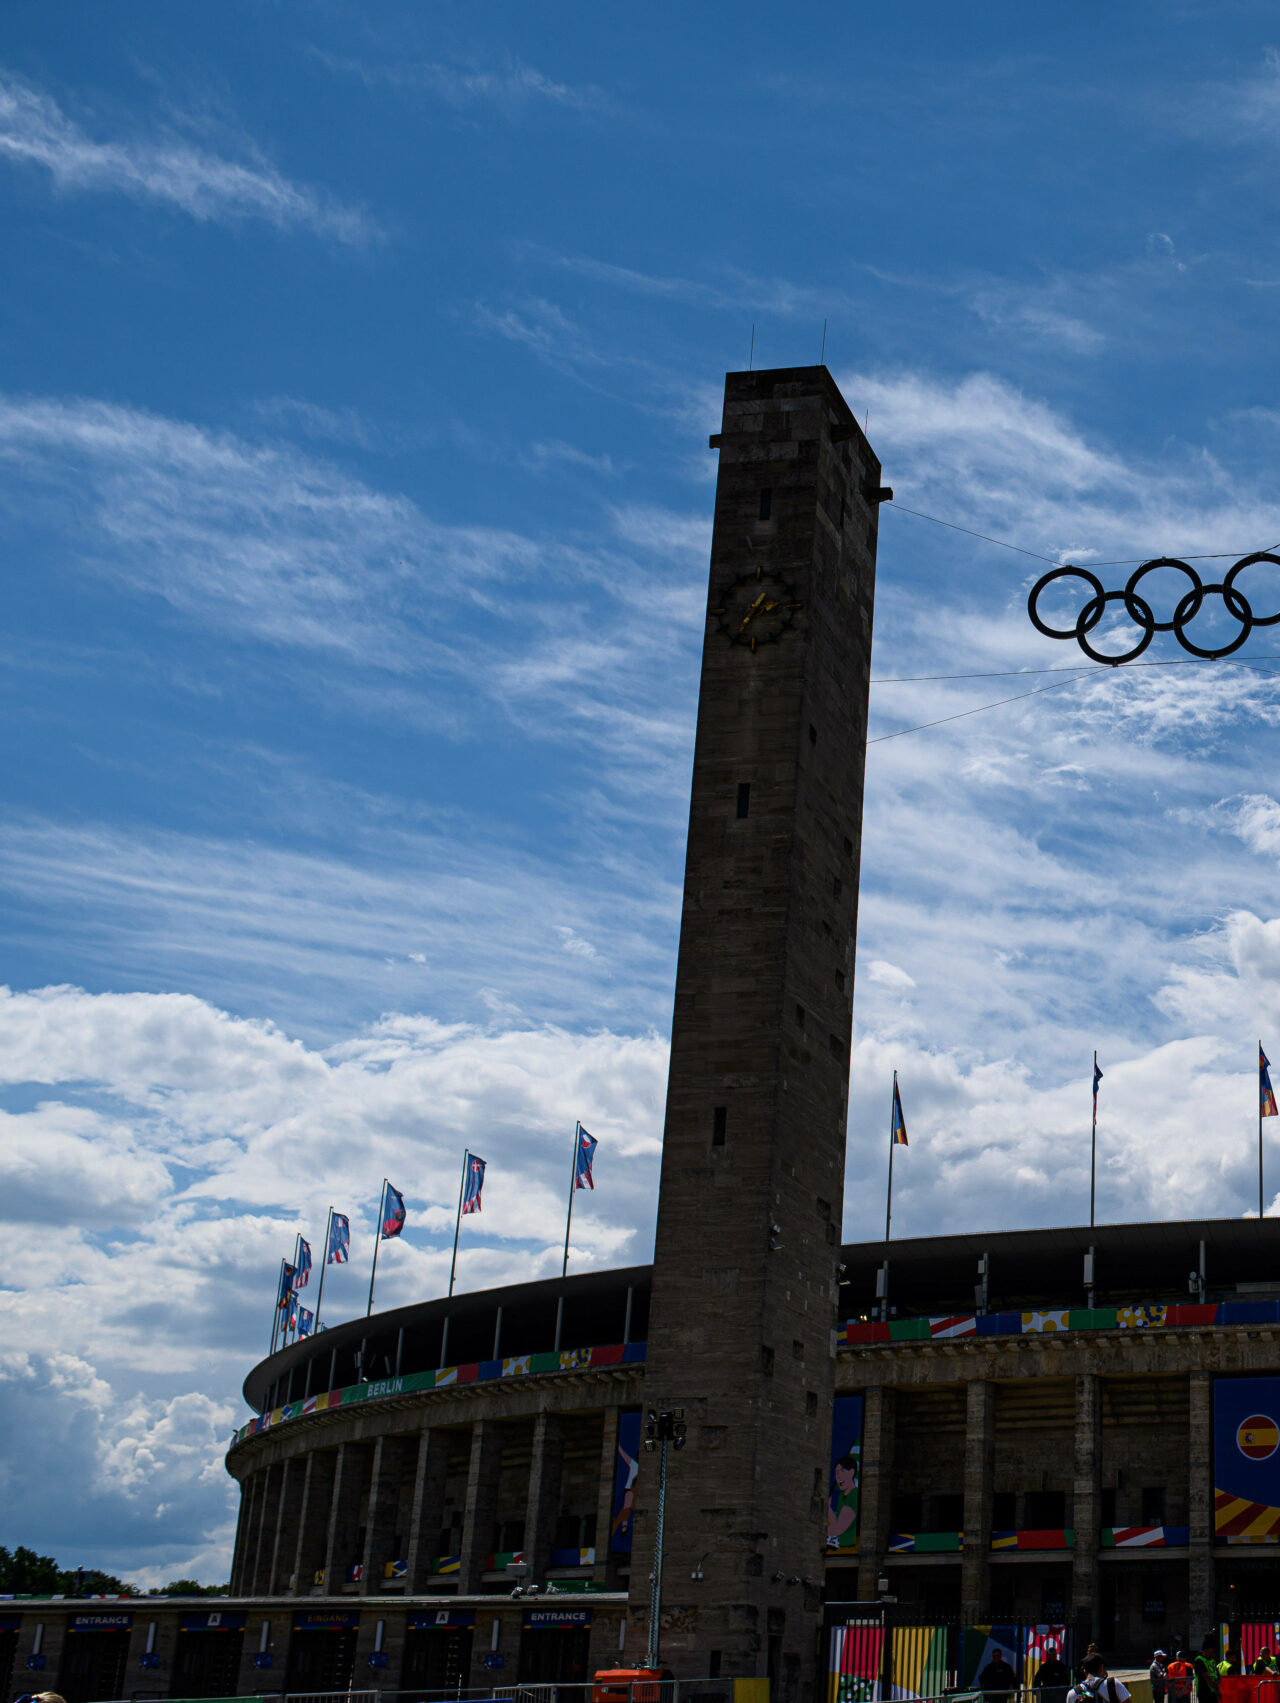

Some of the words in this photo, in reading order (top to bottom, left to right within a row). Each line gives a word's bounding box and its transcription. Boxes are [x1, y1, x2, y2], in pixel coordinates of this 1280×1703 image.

[367, 1378, 403, 1397] BERLIN
[75, 1616, 129, 1625] ENTRANCE
[307, 1613, 349, 1623] EINGANG
[530, 1611, 586, 1621] ENTRANCE
